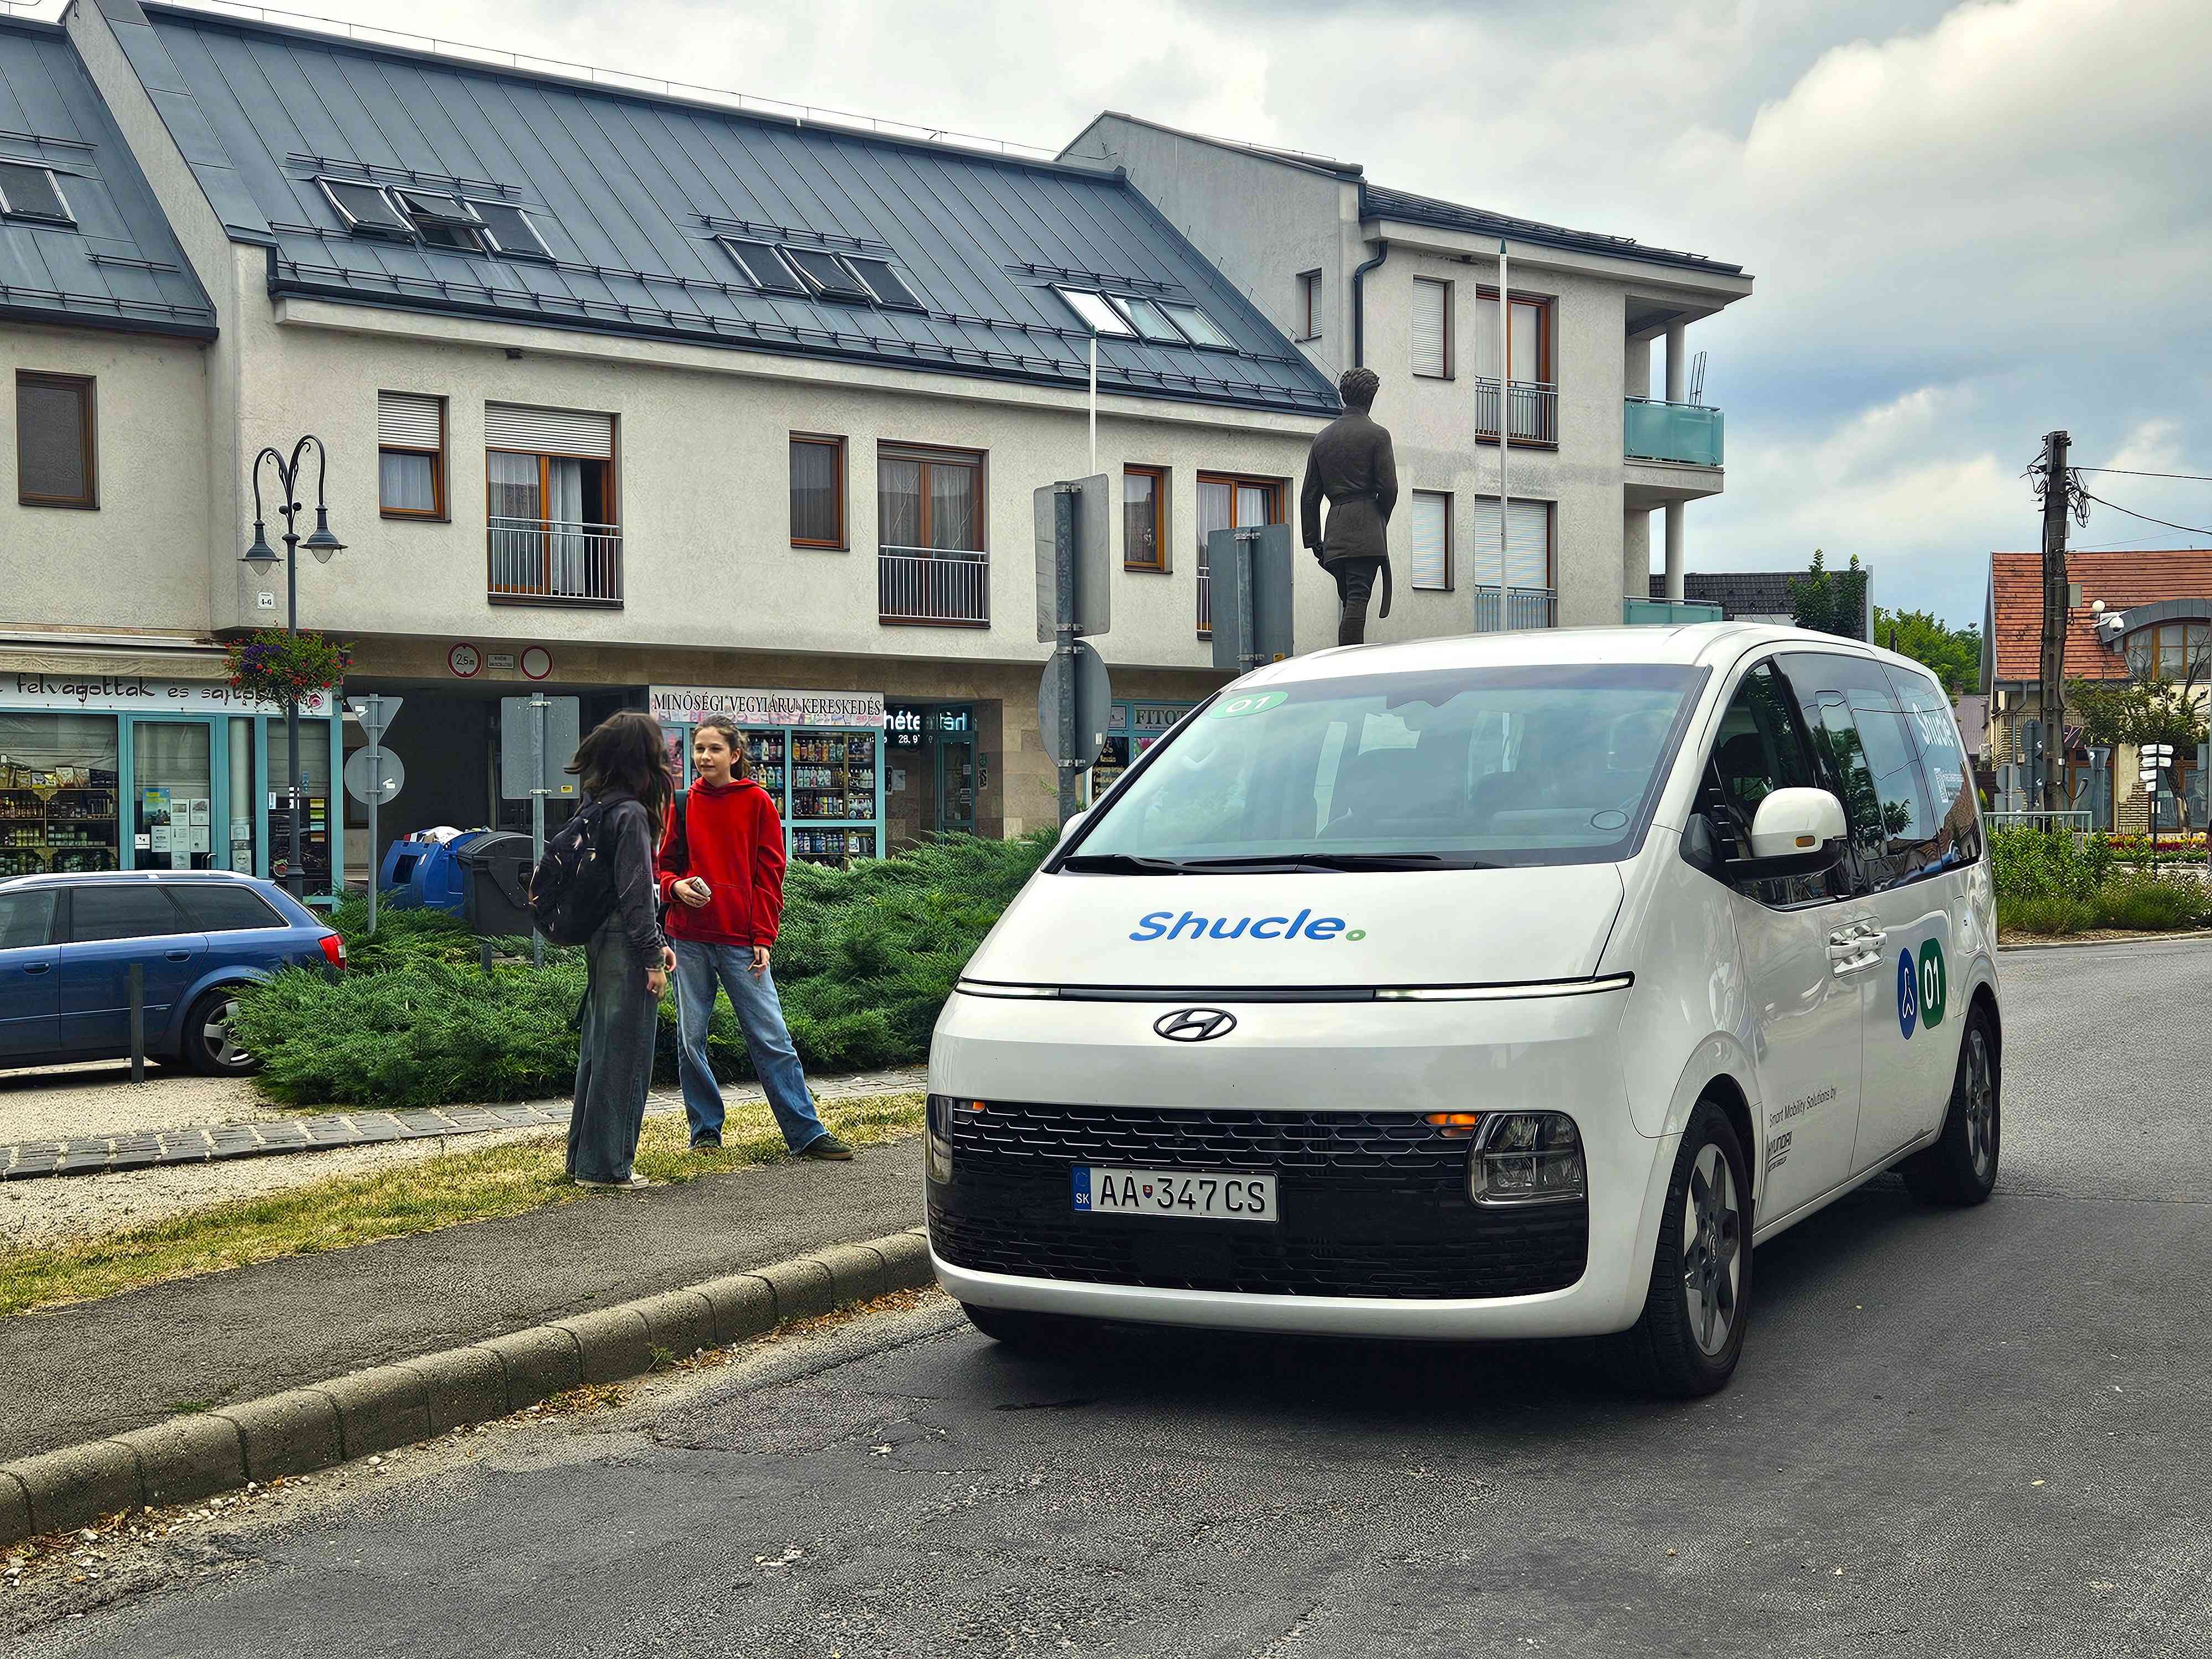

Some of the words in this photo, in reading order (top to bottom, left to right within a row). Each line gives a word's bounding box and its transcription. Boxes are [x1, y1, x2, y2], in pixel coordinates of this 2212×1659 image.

[168, 681, 189, 698] és
[802, 696, 881, 716] KERESKEDÉS
[1225, 695, 1271, 713] 01
[1923, 956, 1941, 1010] 01
[1075, 1193, 1089, 1205] SK
[1099, 1174, 1140, 1207] AA
[1156, 1177, 1266, 1213] 347CS
